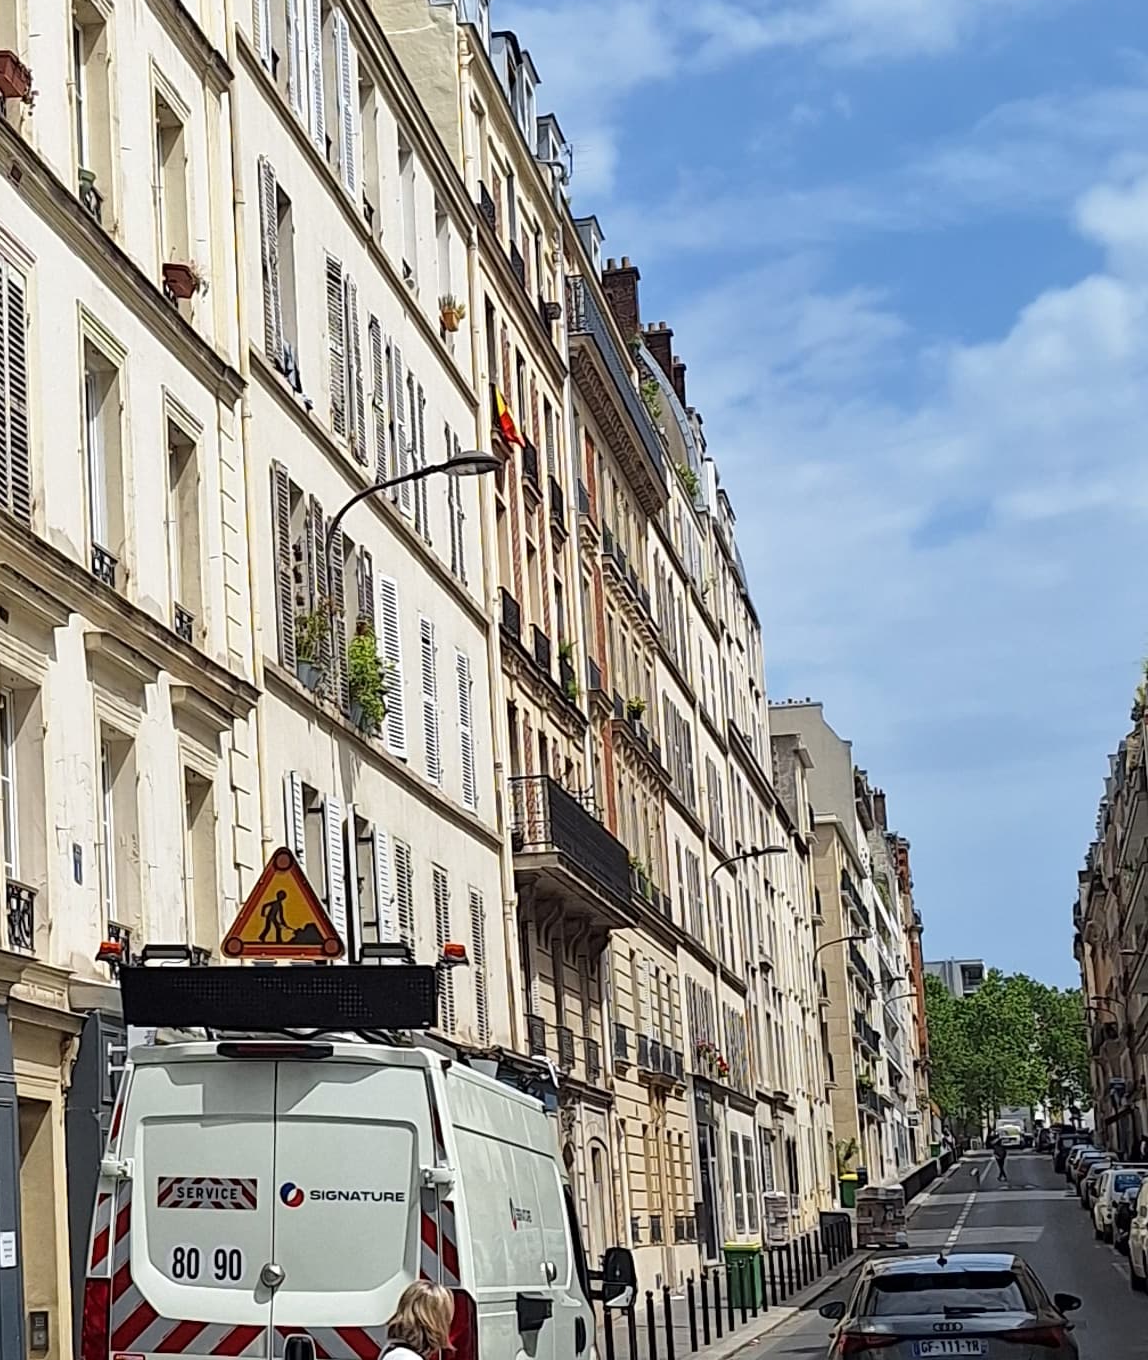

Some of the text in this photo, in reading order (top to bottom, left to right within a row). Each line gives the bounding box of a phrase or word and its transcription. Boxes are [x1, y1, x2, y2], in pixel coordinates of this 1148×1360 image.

[176, 1186, 238, 1201] SERVICE
[309, 1189, 406, 1203] SIGNATURE
[171, 1246, 242, 1281] 80 90
